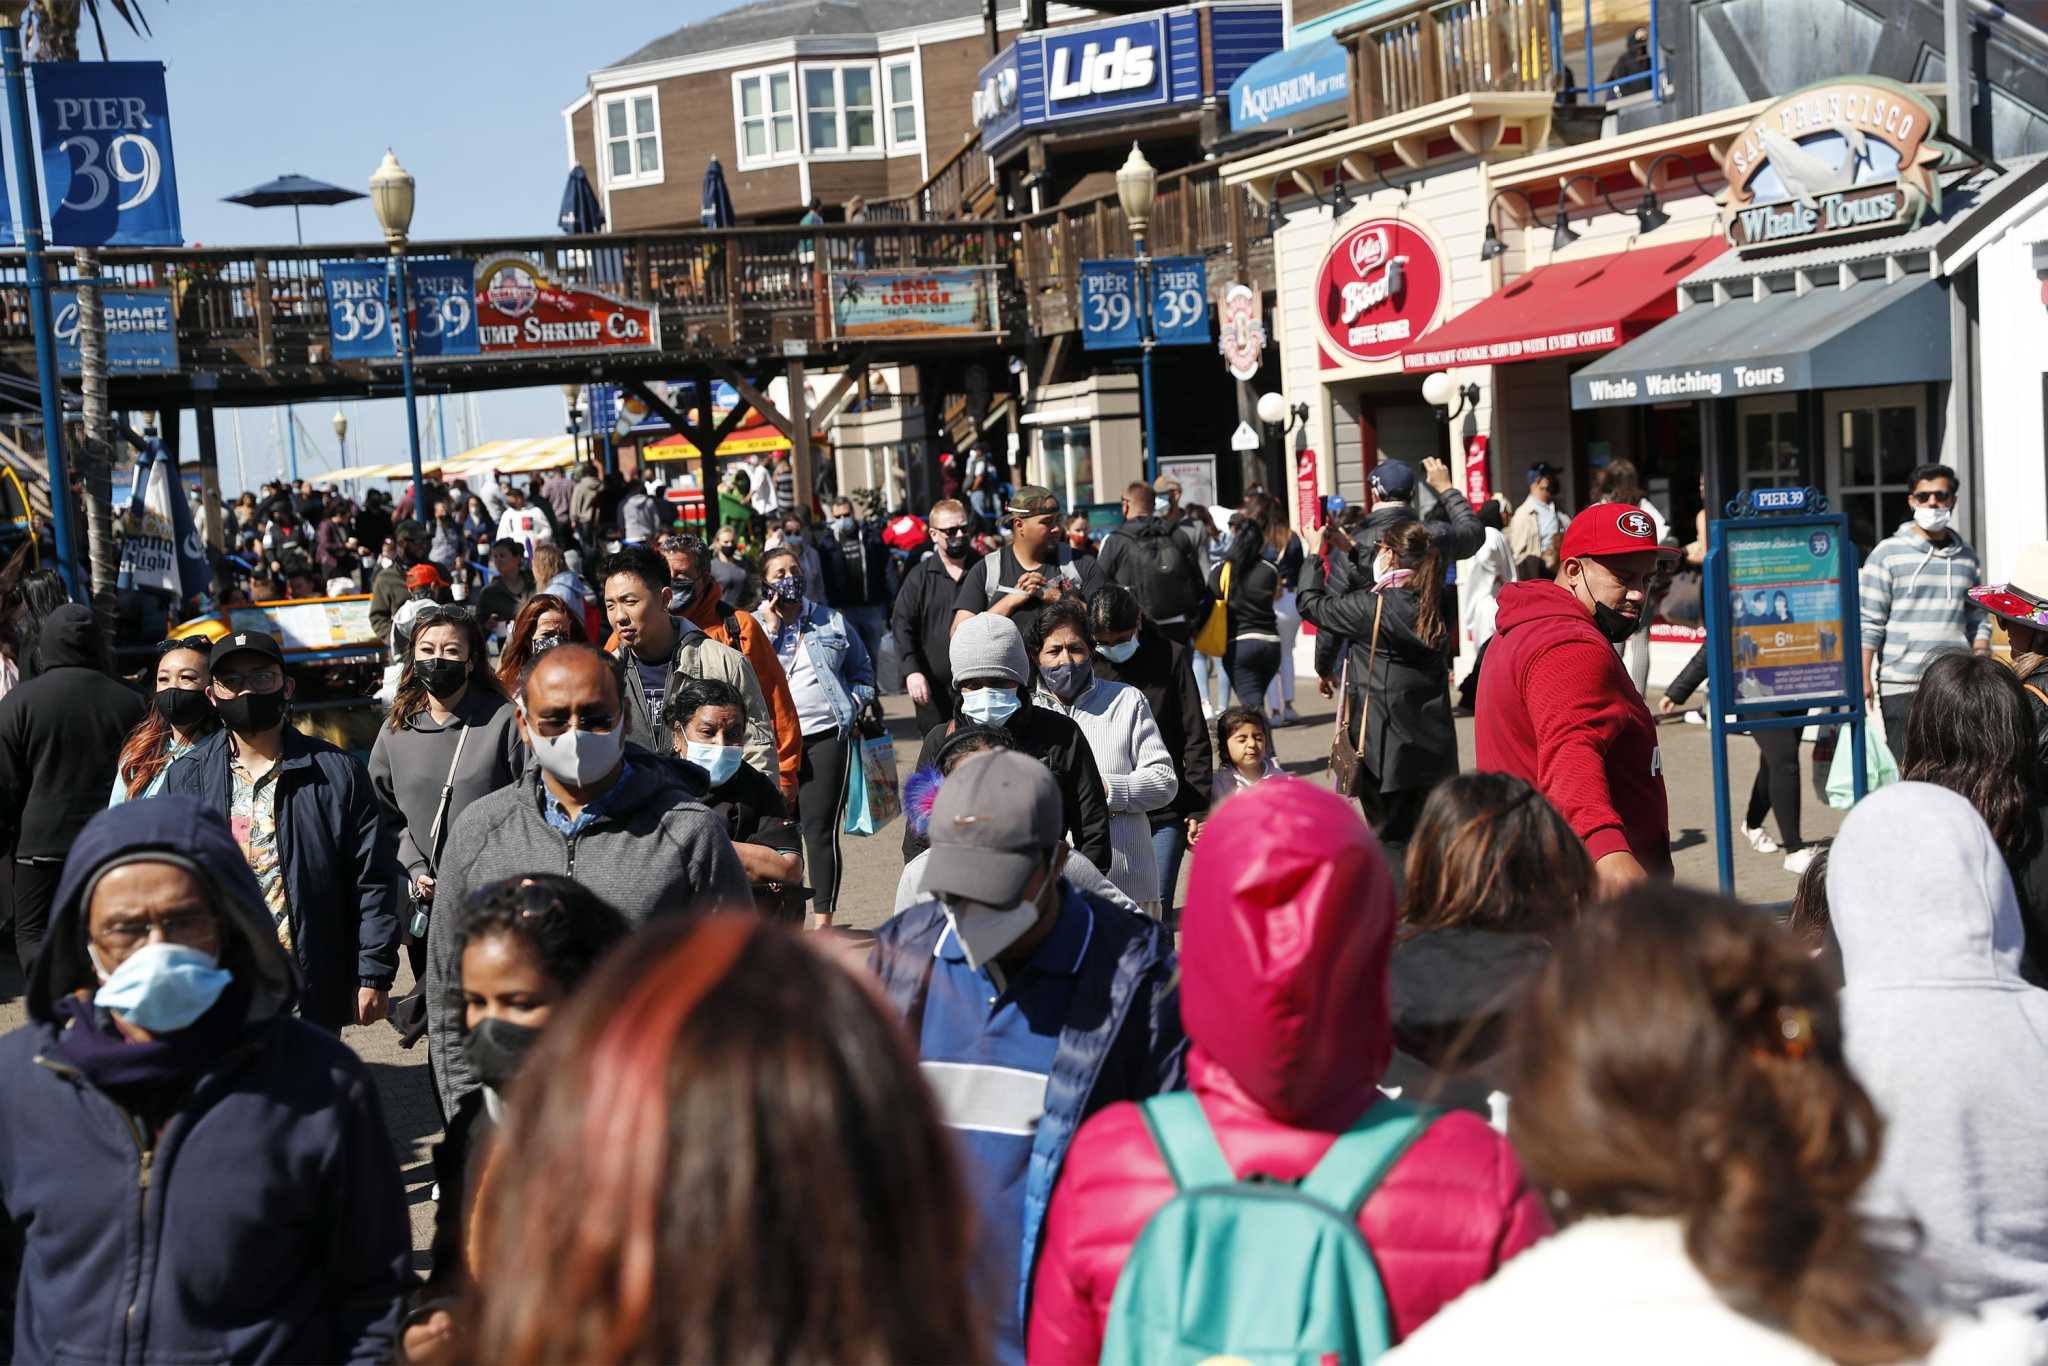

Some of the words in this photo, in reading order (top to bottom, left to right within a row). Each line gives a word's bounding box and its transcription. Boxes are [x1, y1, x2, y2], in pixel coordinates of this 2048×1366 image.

[1050, 37, 1154, 101] Lids
[53, 97, 153, 131] PIER
[1240, 72, 1316, 122] AQUARIUM
[1779, 92, 1915, 141] FRANCISCO
[59, 133, 161, 211] 39
[1738, 200, 1820, 242] Whale
[1819, 193, 1897, 230] Tours
[332, 279, 381, 299] PIER
[417, 276, 468, 296] PIER
[1087, 274, 1129, 293] PIER
[1158, 271, 1200, 290] PIER
[104, 319, 168, 332] HOUSE
[333, 299, 386, 342] 39
[419, 295, 471, 339] 39
[1087, 293, 1132, 333] 39
[1158, 289, 1203, 329] 39
[524, 317, 602, 343] SHRIMP
[1522, 337, 1548, 353] WITH
[1589, 378, 1638, 401] Whale
[1645, 370, 1722, 396] Watching
[1734, 365, 1784, 388] Tours
[1759, 491, 1789, 506] PIER
[1790, 491, 1804, 505] 39
